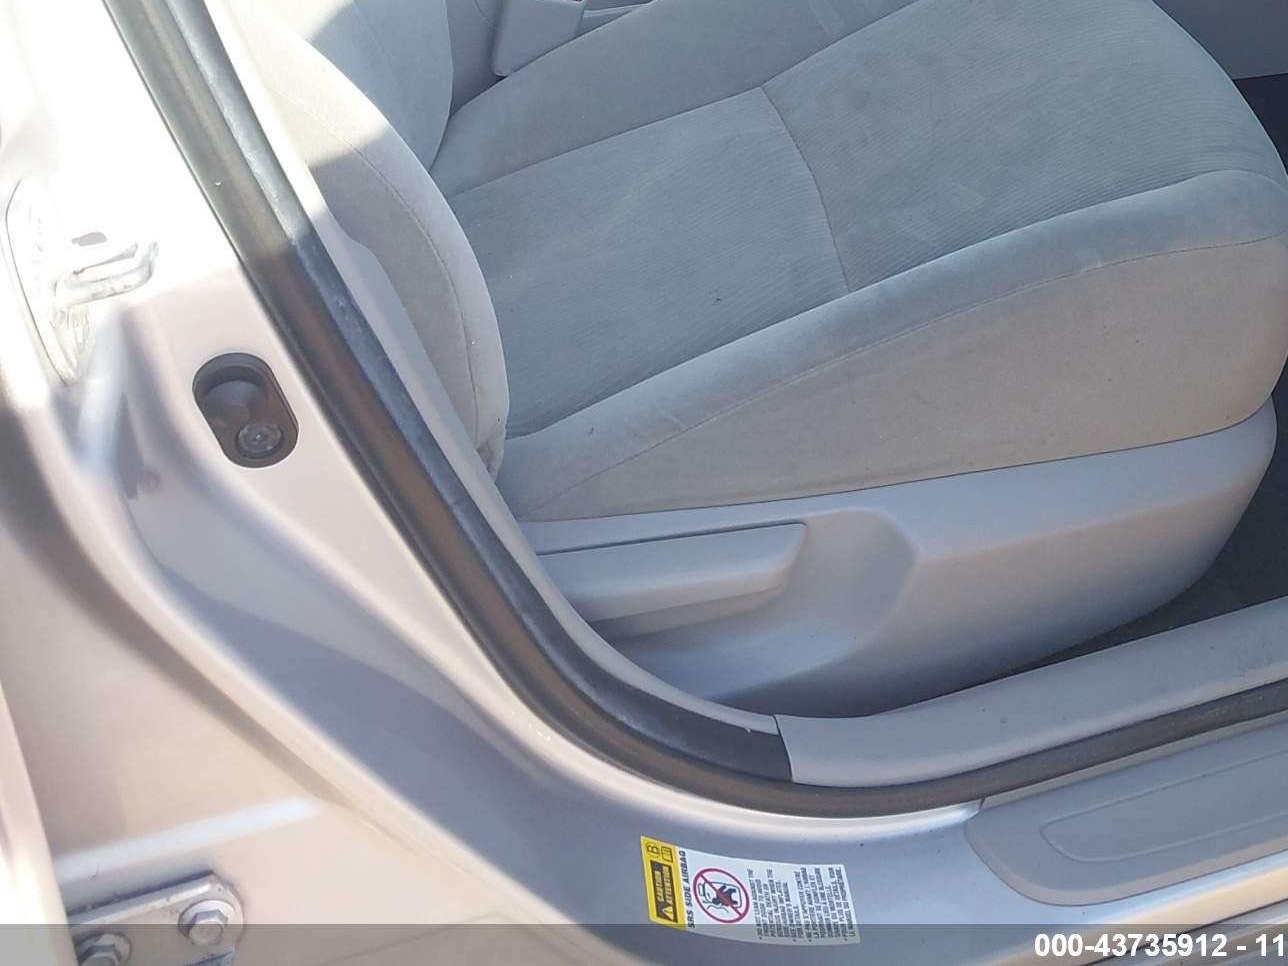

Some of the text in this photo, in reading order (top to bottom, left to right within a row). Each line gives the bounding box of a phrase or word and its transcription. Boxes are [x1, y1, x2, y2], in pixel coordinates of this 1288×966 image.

[655, 871, 664, 902] CAUTION
[662, 866, 672, 904] ATTENTION
[679, 850, 695, 928] SRS SIDE AIRBAG
